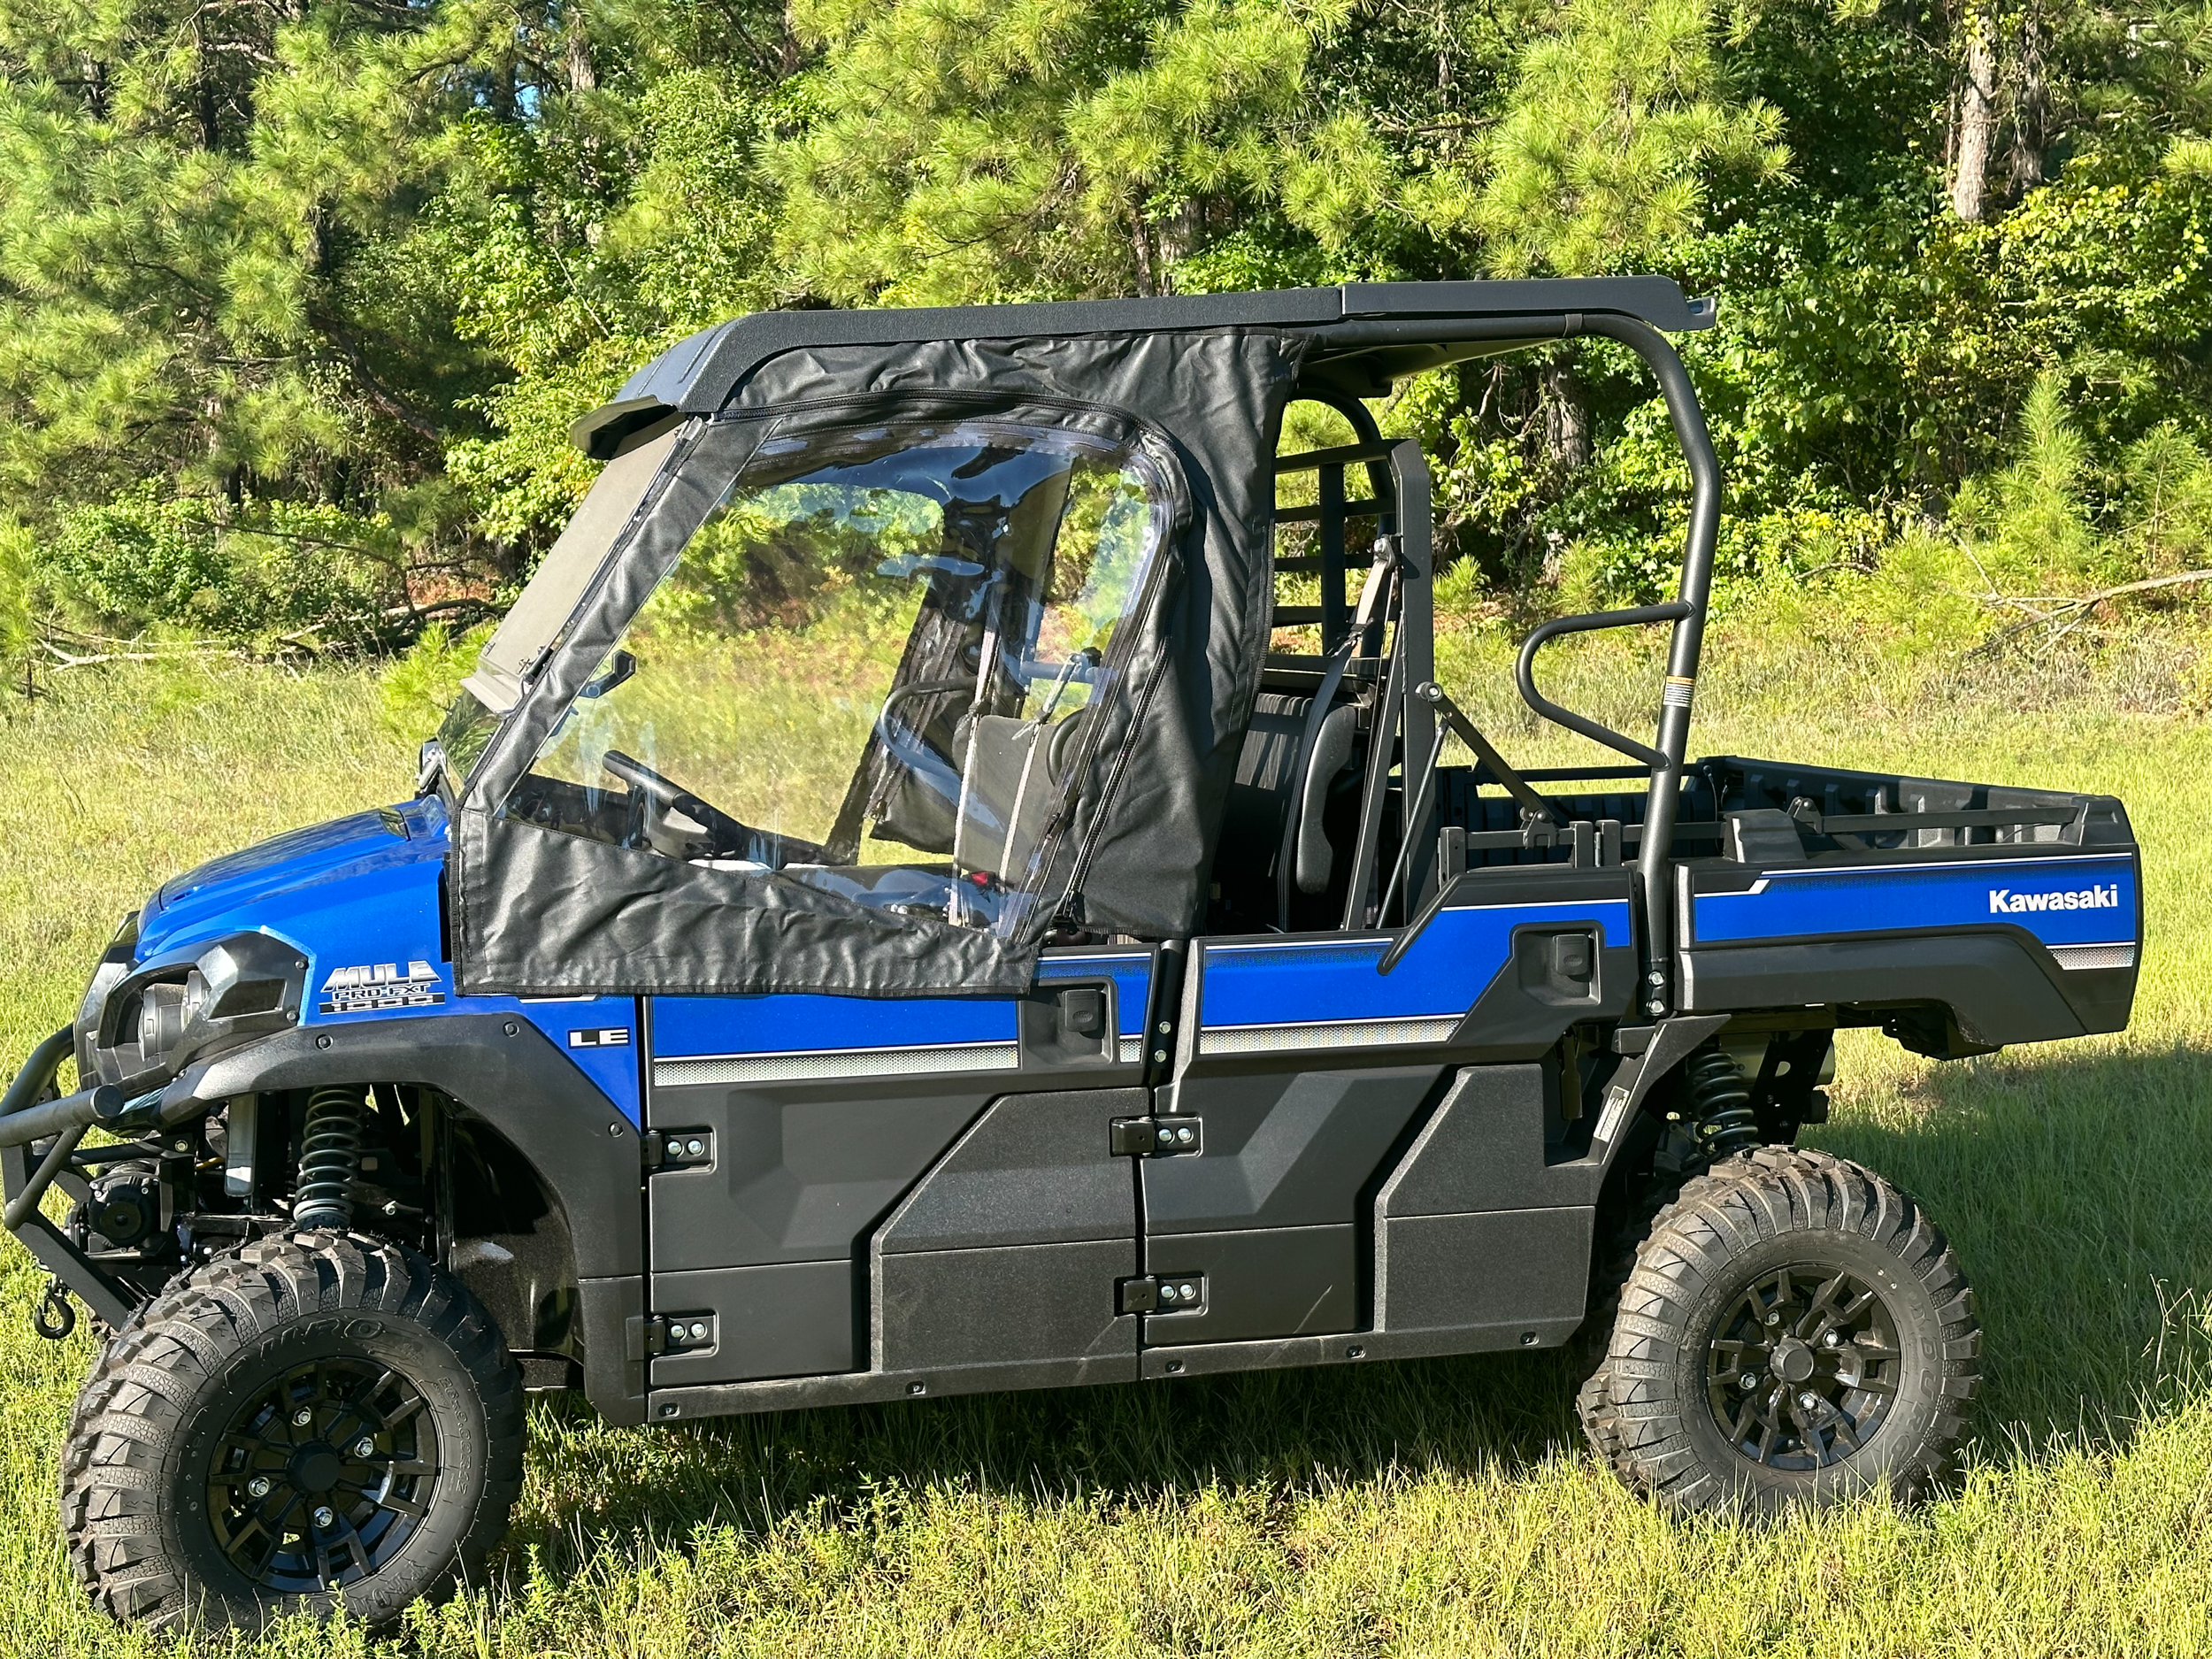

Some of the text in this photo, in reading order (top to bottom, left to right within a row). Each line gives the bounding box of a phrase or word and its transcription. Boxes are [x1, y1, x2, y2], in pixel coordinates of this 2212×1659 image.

[1988, 883, 2118, 914] Kawasaki
[319, 960, 442, 993] MULE
[331, 995, 434, 1011] 1000
[570, 1028, 628, 1047] LE
